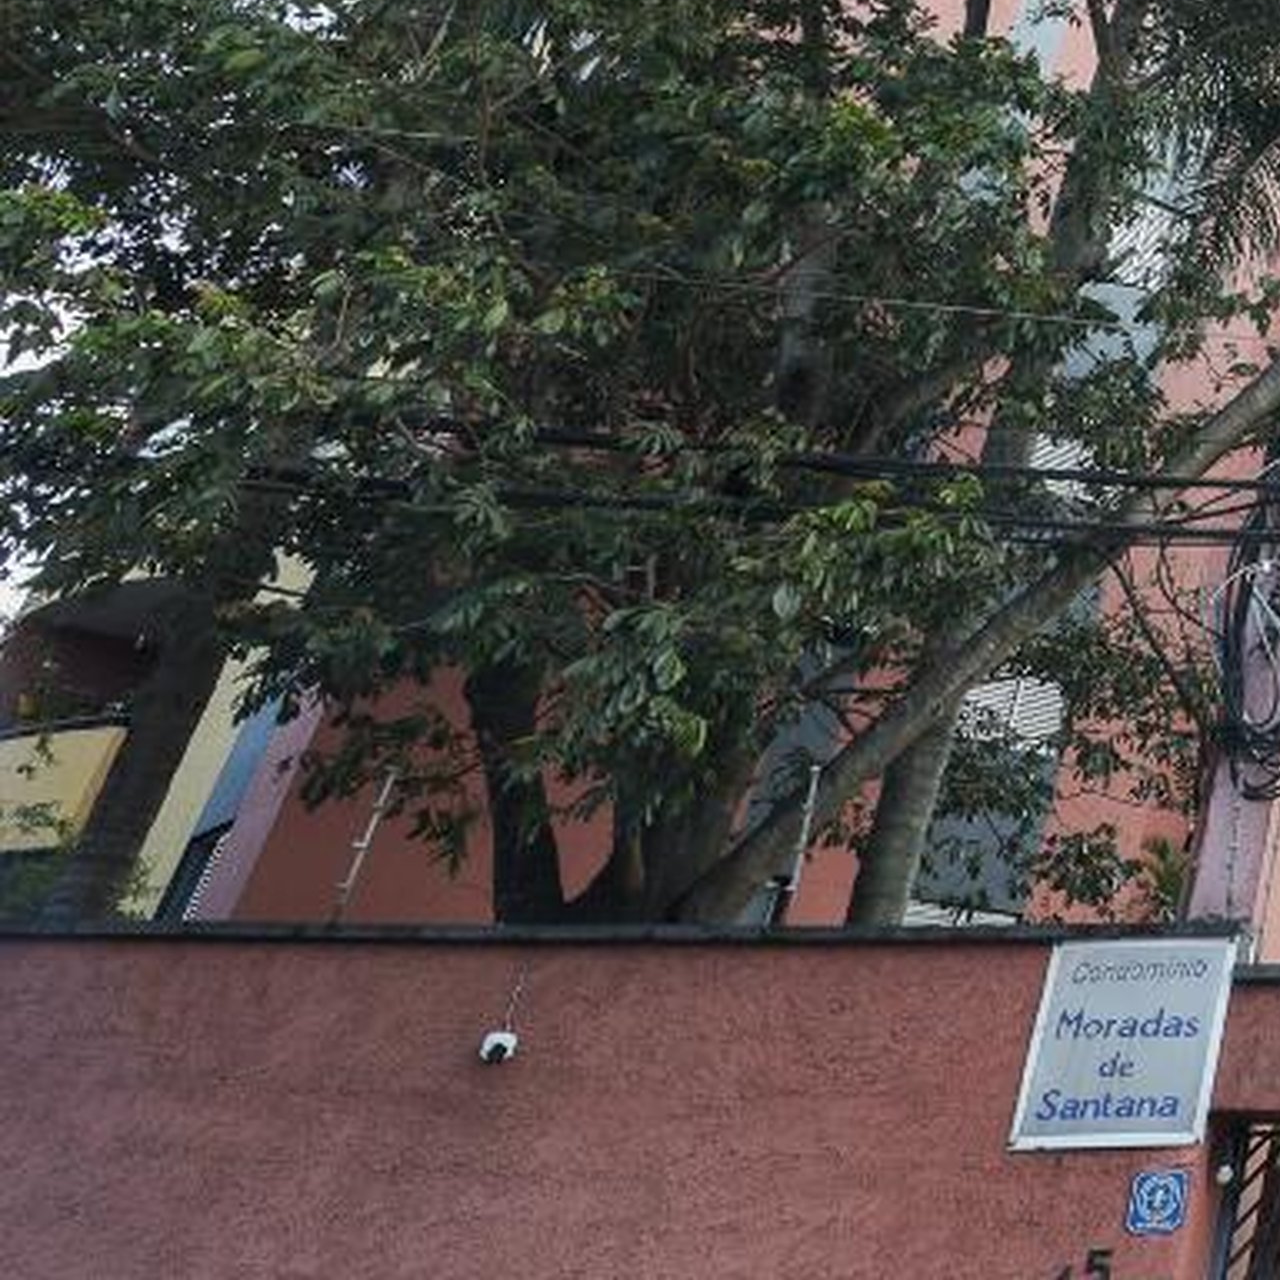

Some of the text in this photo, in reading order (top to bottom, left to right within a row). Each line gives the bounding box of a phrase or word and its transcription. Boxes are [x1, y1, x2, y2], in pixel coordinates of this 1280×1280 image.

[1055, 1008, 1200, 1039] Moradas
[1099, 1050, 1134, 1077] de
[1035, 1089, 1179, 1120] Santana
